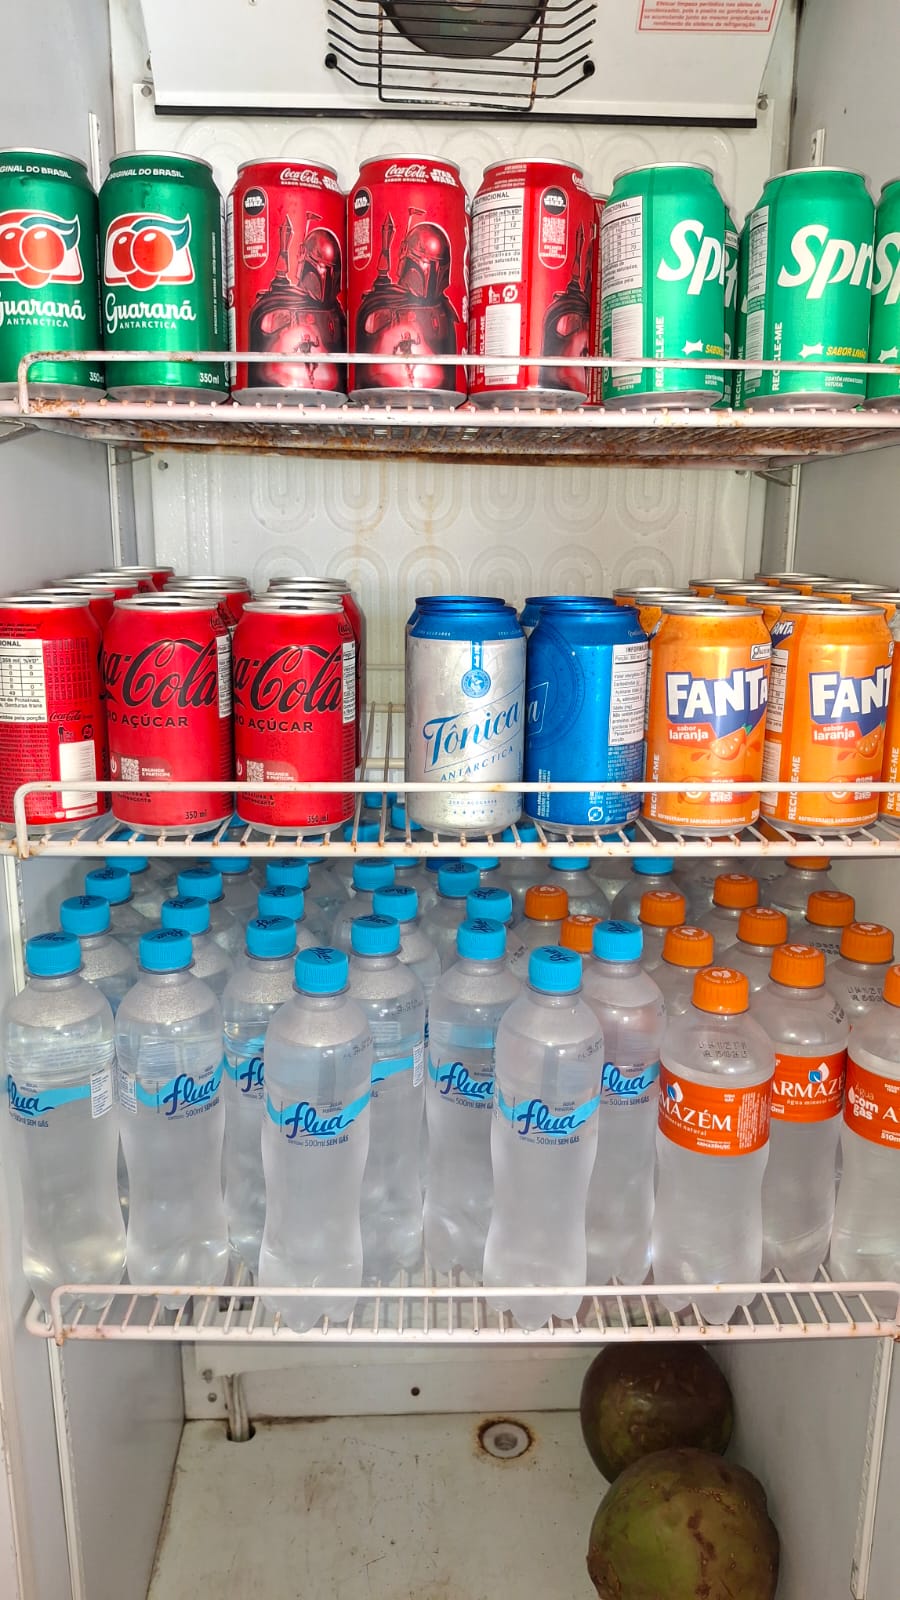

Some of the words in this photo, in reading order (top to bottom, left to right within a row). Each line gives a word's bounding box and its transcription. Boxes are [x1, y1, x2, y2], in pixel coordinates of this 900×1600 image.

[0, 165, 24, 173] GINAL
[26, 165, 39, 173] DO
[41, 167, 72, 179] BRASIL
[139, 168, 152, 176] DO
[153, 168, 185, 179] BRASIL
[280, 167, 321, 184] Coca-Cola
[384, 164, 429, 179] Coca-Cola
[430, 168, 451, 177] STAR
[105, 292, 197, 334] Guaraná
[7, 318, 69, 328] ANTARCTICA
[119, 321, 177, 329] ANTARCTICA
[825, 346, 852, 357] SABOR
[772, 621, 793, 635] ANTA
[667, 667, 768, 719] FANTA
[121, 712, 189, 729] AÇÚCAR
[248, 717, 313, 733] AÇÚCAR
[423, 701, 519, 766] Tônica
[669, 729, 709, 742] laranja
[677, 724, 697, 733] sabor
[813, 729, 856, 742] laranja
[823, 724, 844, 733] sabor
[441, 745, 513, 782] ANTARCTICA
[184, 810, 198, 820] 350
[240, 1057, 264, 1092] fl
[440, 1062, 494, 1095] flua
[162, 1073, 221, 1116] flua
[609, 1098, 629, 1106] 500ml
[517, 1099, 586, 1135] flua
[660, 1093, 732, 1132] MAZÉM
[285, 1102, 354, 1139] flua
[304, 1138, 325, 1148] 500ml
[325, 1138, 338, 1147] SEM
[338, 1135, 349, 1145] GÁS
[536, 1137, 557, 1146] 500ml
[558, 1137, 569, 1146] SEM
